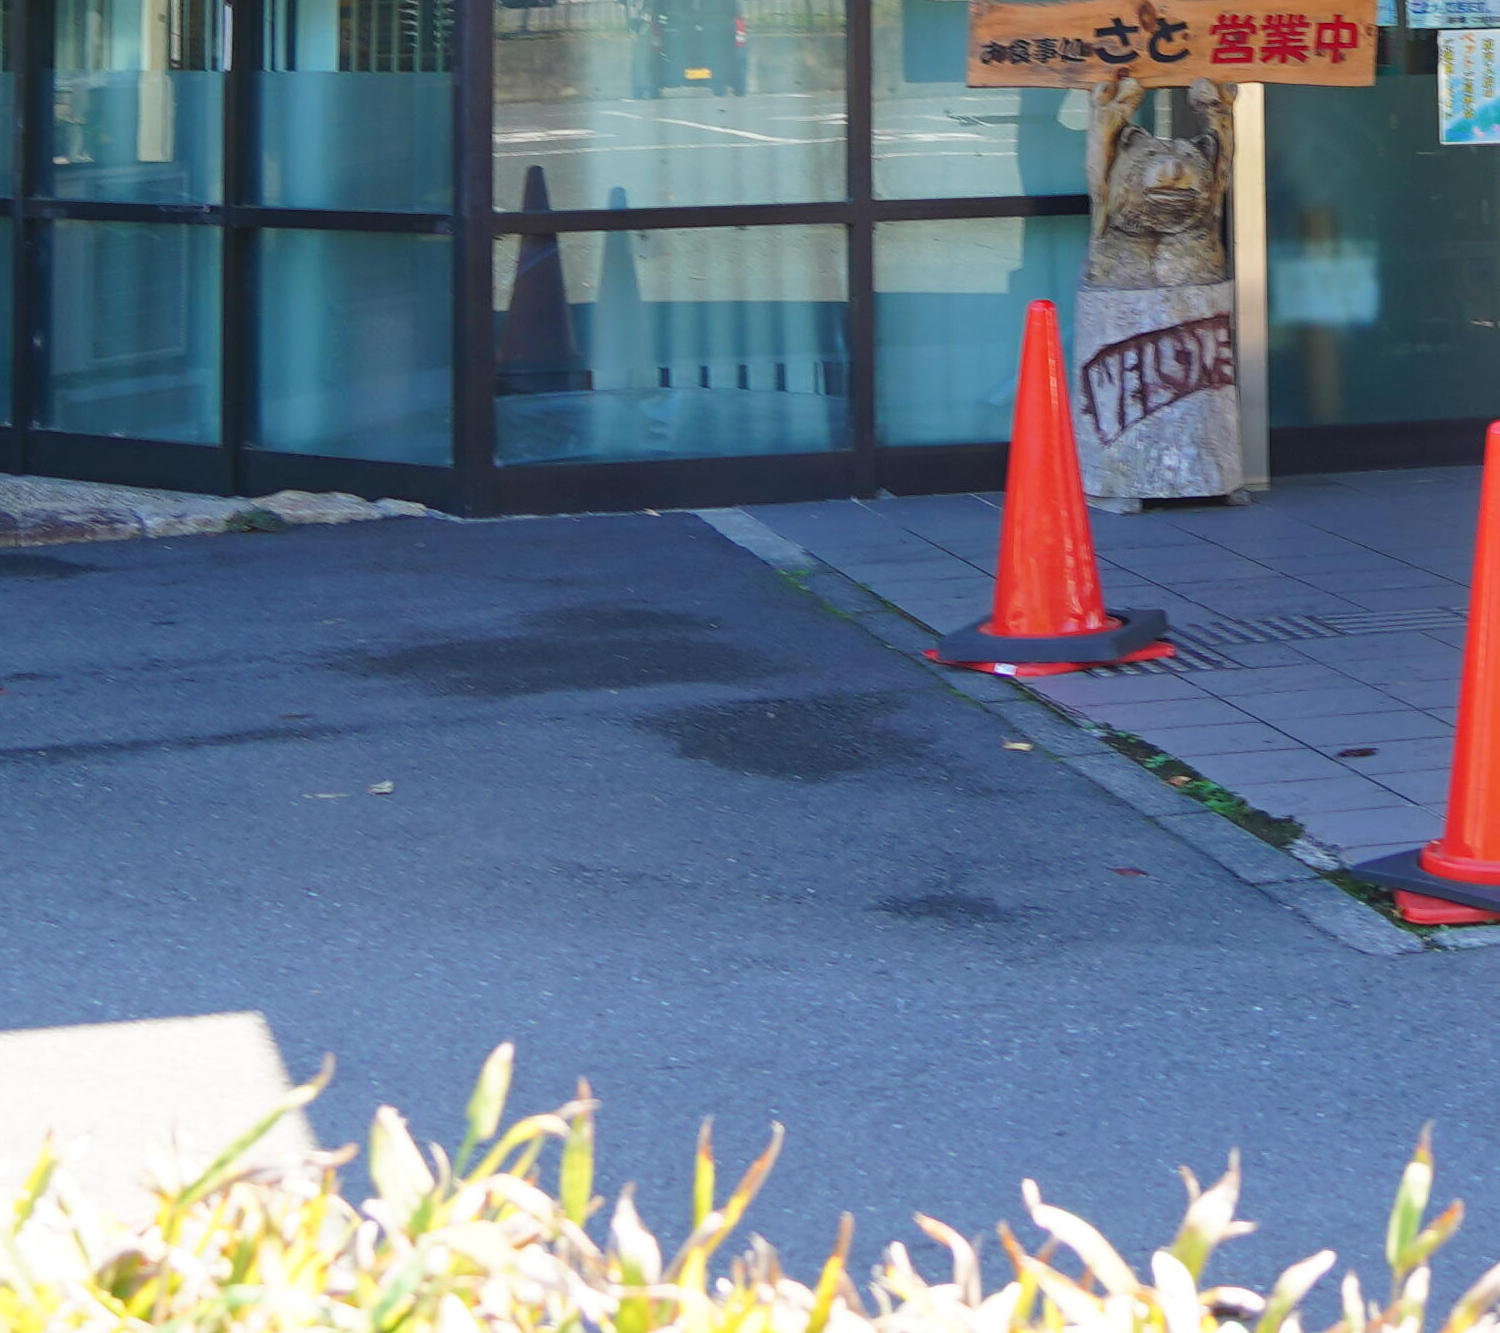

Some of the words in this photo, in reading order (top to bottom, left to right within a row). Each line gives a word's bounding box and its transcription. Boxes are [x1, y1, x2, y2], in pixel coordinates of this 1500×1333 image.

[1094, 15, 1191, 65] さと
[1210, 13, 1359, 65] 営業中
